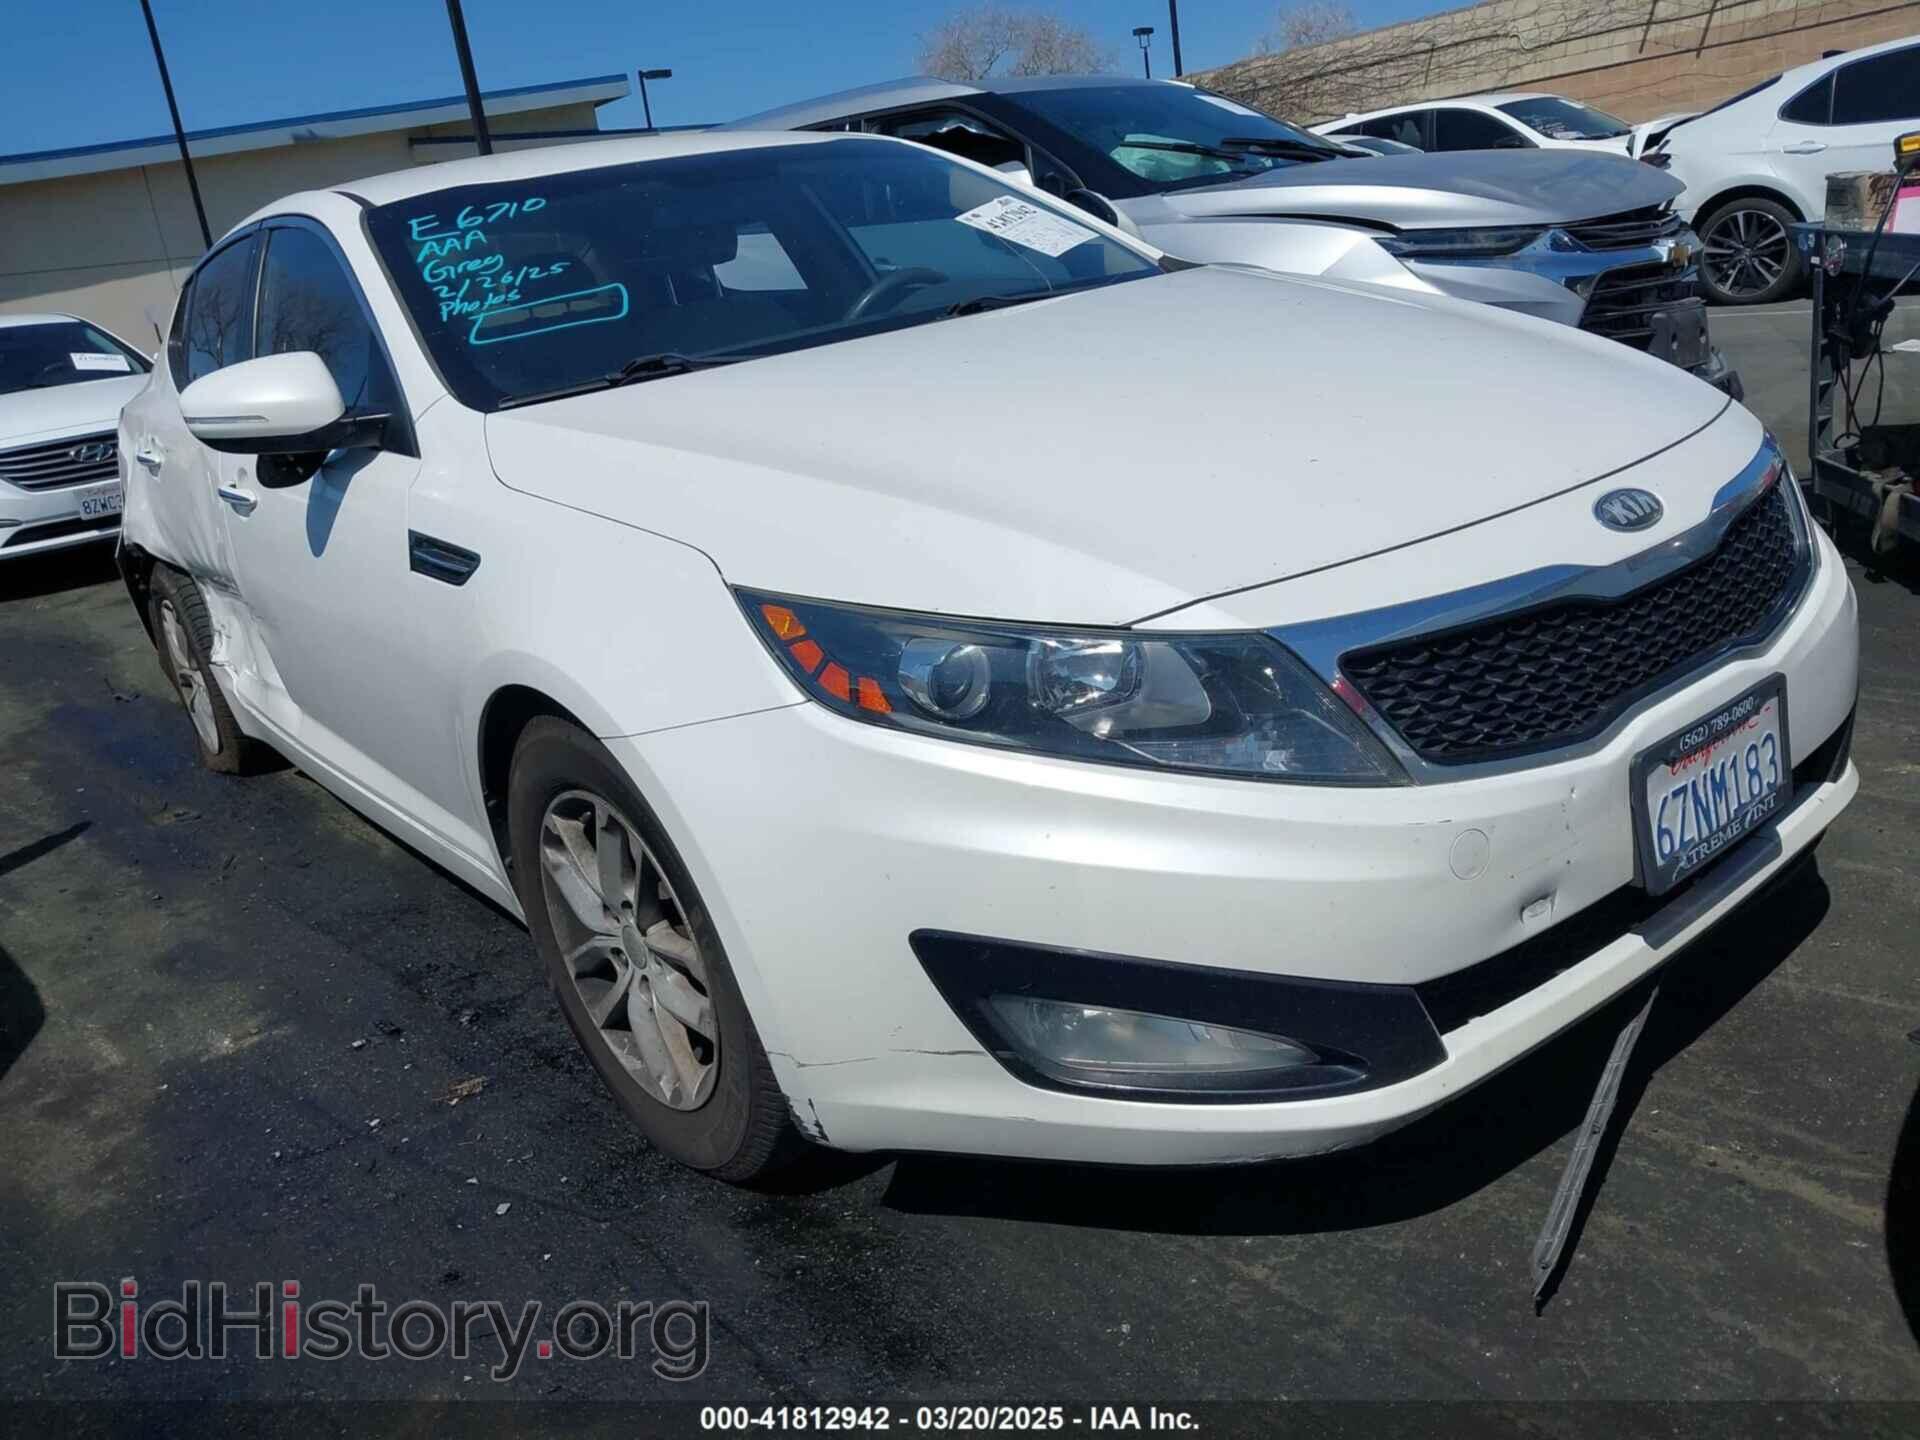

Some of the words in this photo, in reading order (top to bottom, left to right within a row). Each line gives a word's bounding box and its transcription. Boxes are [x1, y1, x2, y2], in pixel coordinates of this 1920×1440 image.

[456, 197, 546, 230] 6710
[417, 229, 487, 263] AAA
[1680, 723, 1709, 752] (562)
[1656, 732, 1778, 862] 6ZNM183
